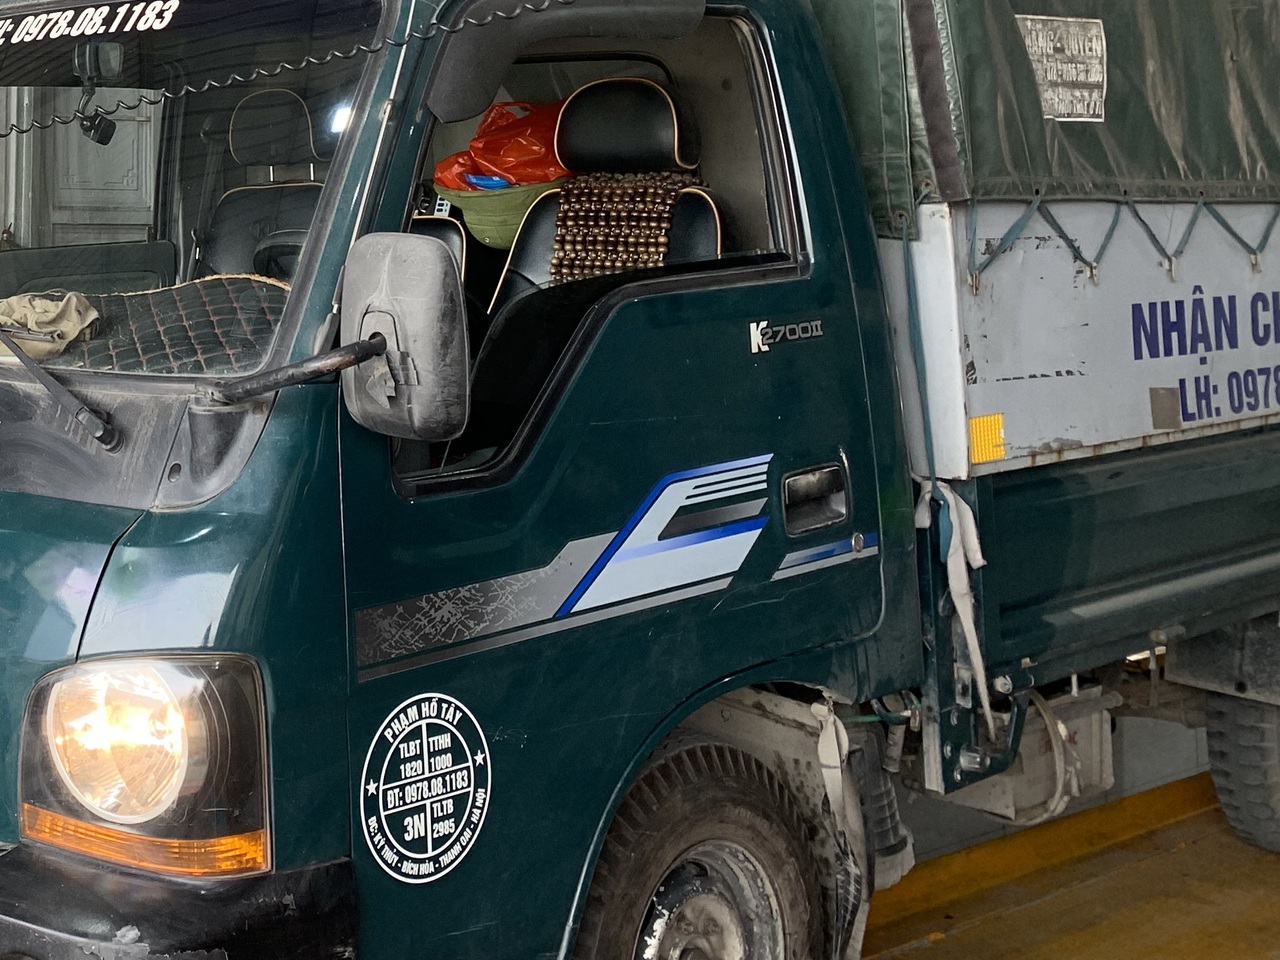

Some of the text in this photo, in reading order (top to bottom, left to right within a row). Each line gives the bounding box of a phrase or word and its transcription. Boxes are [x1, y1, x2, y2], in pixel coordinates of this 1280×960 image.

[10, 0, 181, 44] 0978.08.1183
[1131, 285, 1239, 366] NHẬN
[1178, 374, 1222, 422] LH:
[383, 704, 419, 743] PHẠM
[440, 703, 463, 726] TÂY
[398, 732, 452, 759] TLBT TTHH
[400, 752, 453, 779] 1820 1000
[404, 769, 469, 804] 0978.08.1183
[403, 798, 454, 842] 3N TLTB
[432, 818, 456, 839] 2985
[438, 841, 463, 868] THANH
[459, 827, 473, 847] OAI
